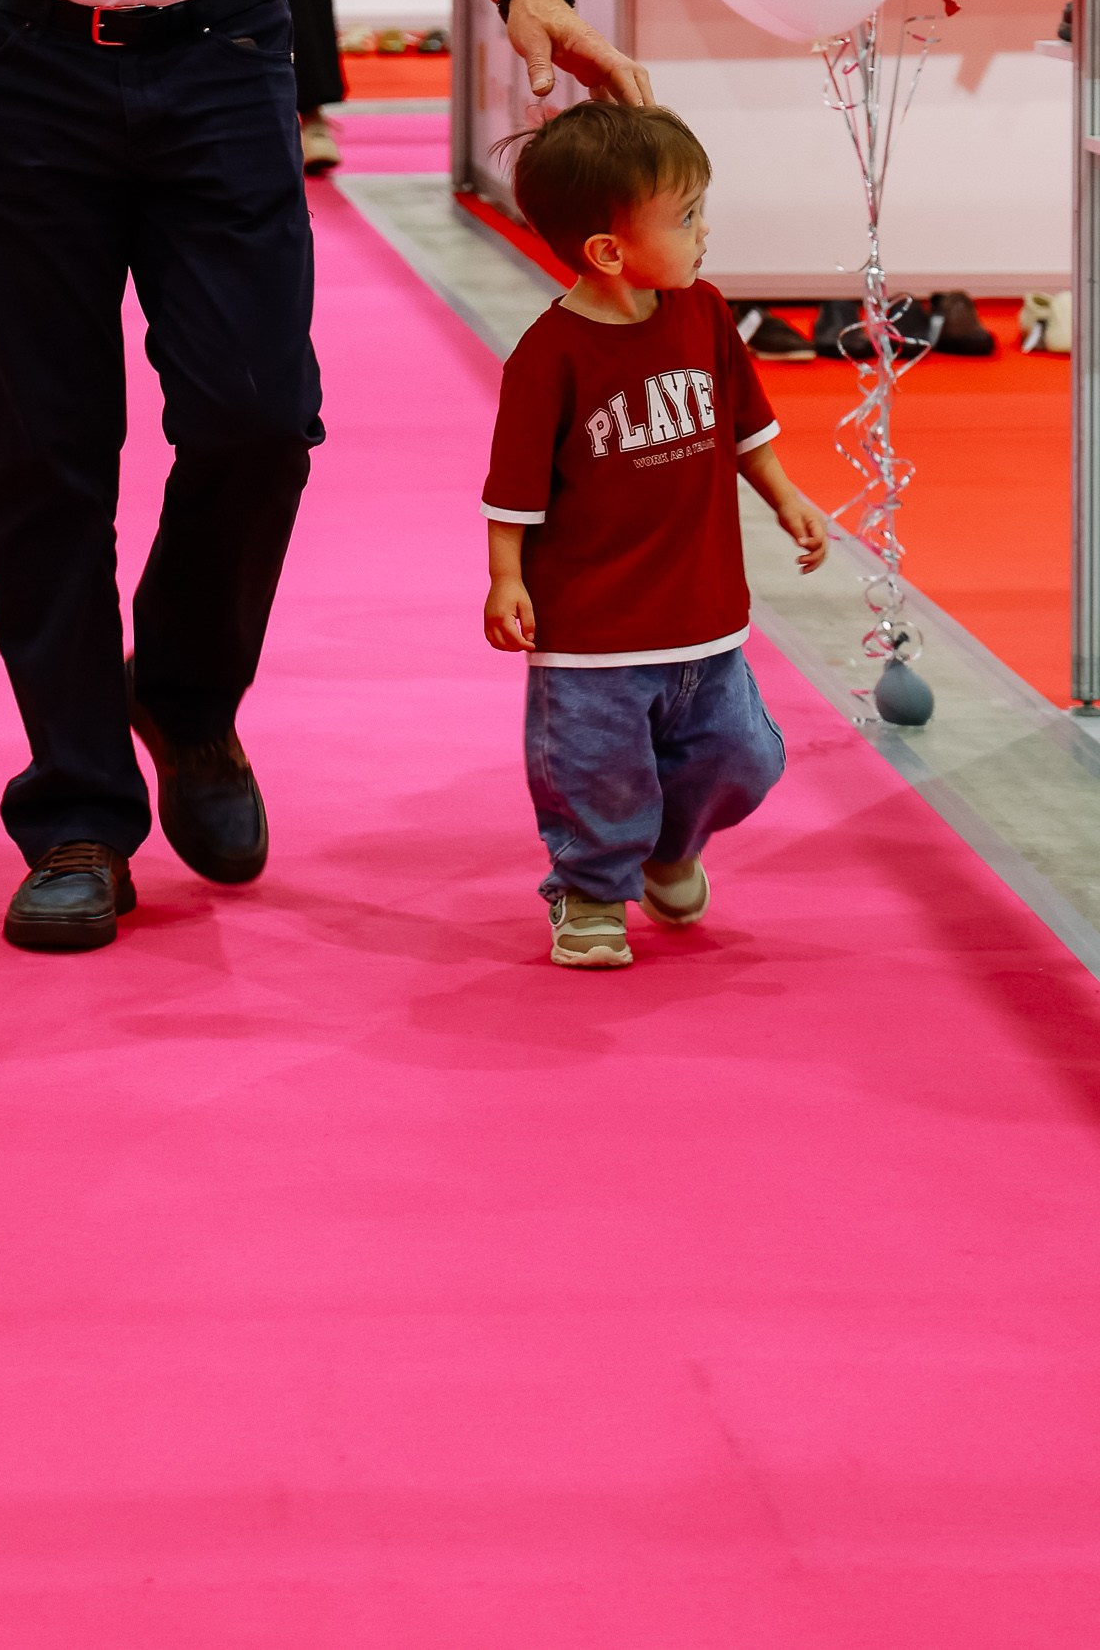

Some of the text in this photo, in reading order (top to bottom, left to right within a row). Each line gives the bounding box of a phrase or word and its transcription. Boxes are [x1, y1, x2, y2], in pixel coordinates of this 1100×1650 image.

[584, 368, 716, 458] PLAYE
[633, 452, 669, 469] WORK
[670, 448, 685, 462] AS
[685, 445, 693, 457] A
